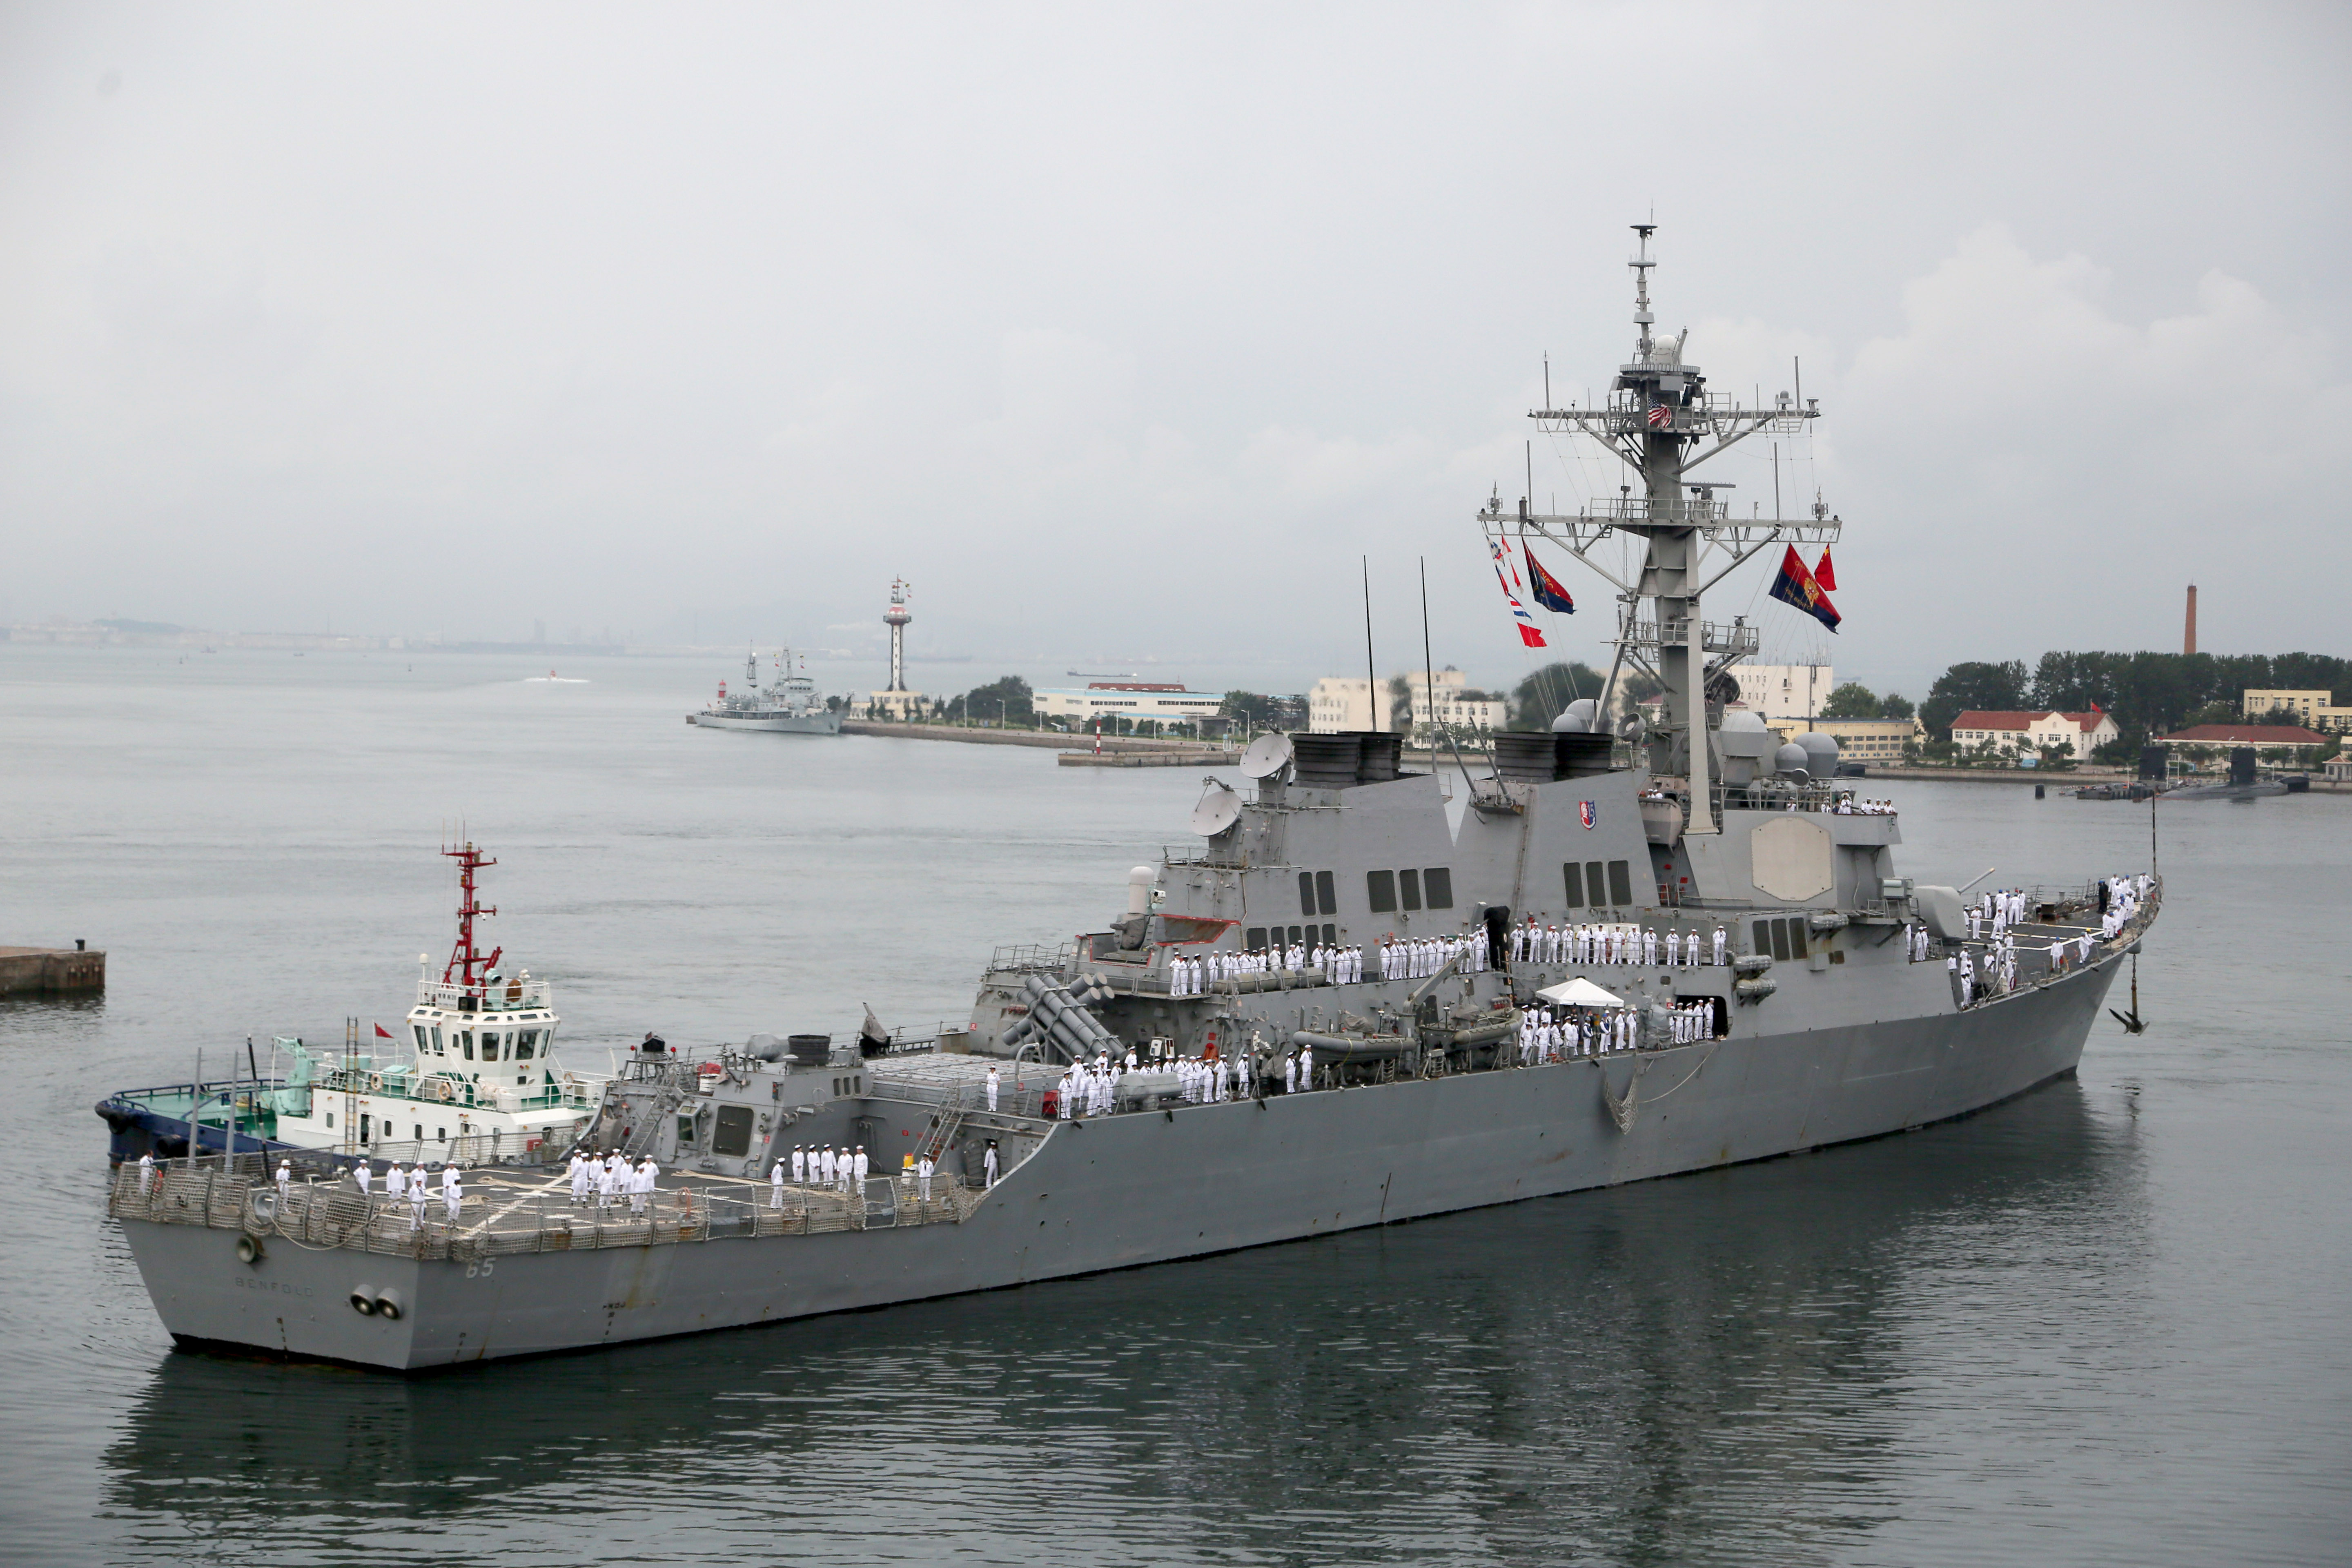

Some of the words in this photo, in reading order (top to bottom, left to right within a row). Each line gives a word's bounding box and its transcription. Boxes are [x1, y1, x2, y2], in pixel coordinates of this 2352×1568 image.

[1588, 804, 1595, 817] 15
[466, 1257, 496, 1278] 65
[235, 1277, 313, 1297] BENFOLD
